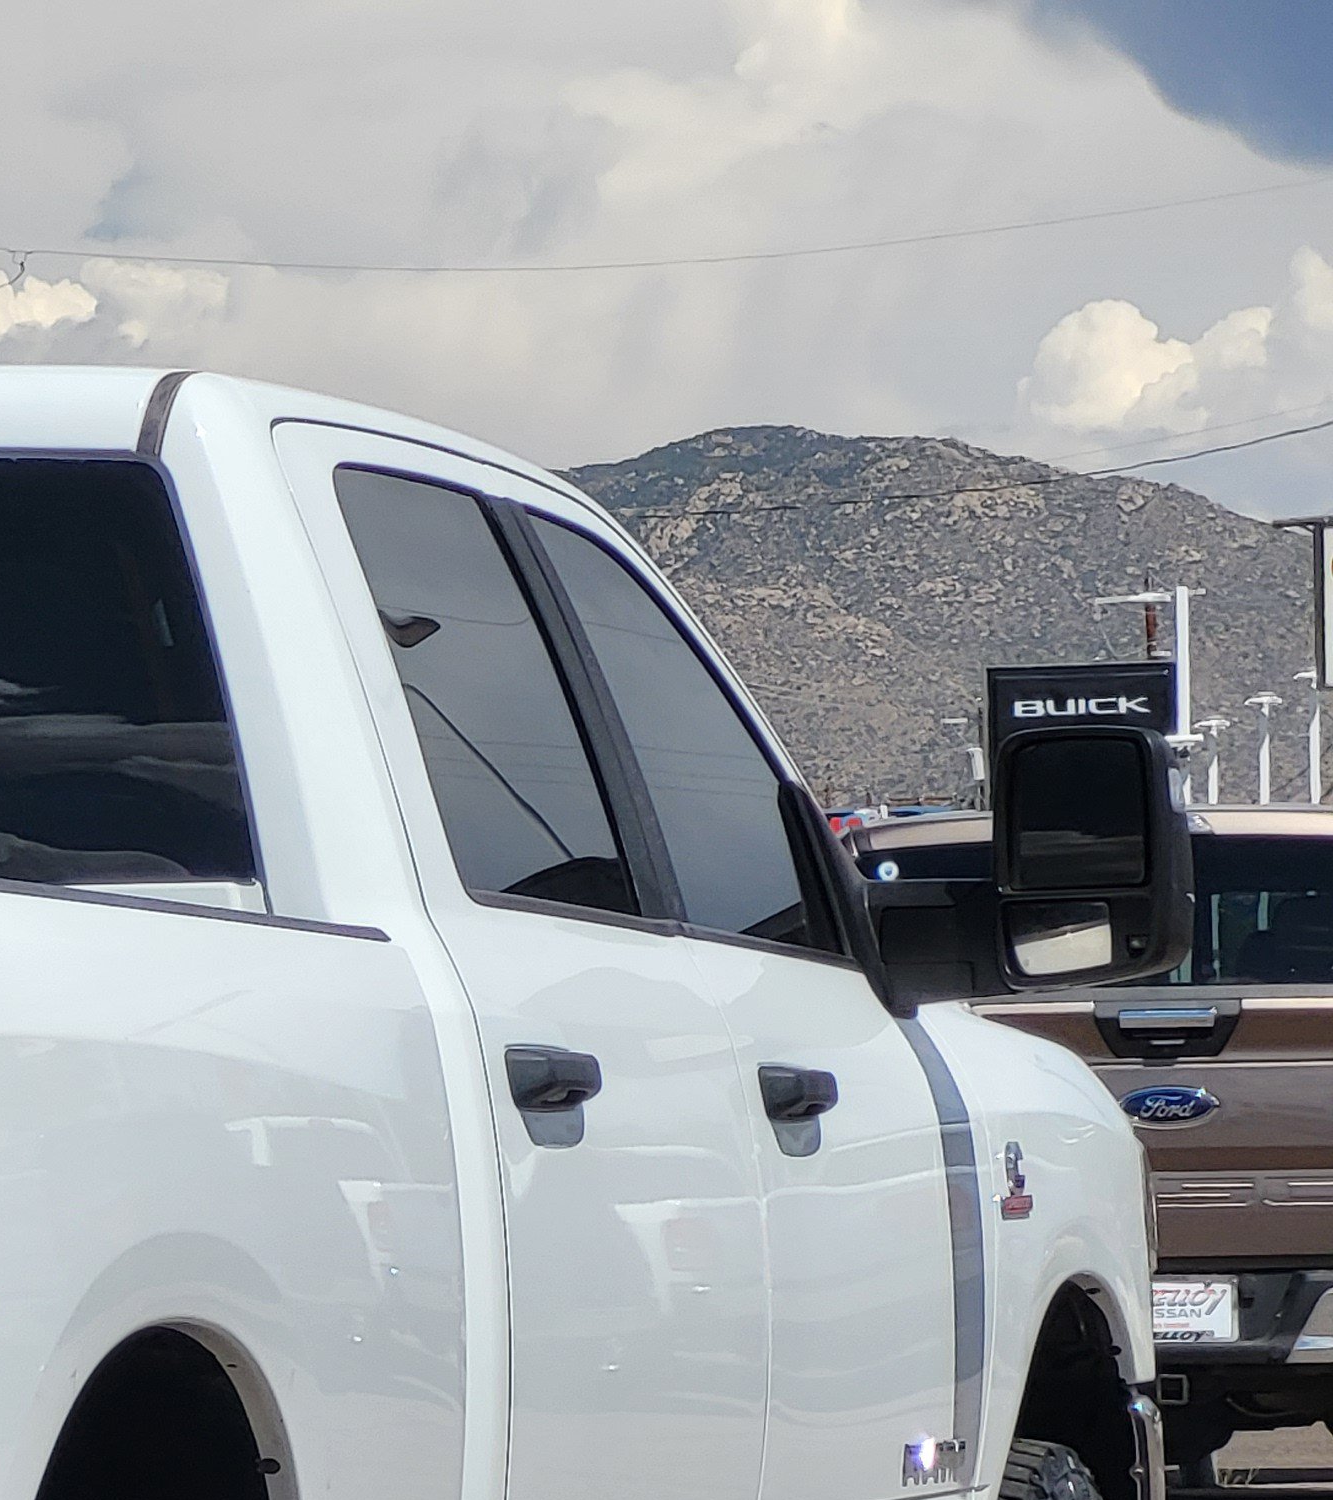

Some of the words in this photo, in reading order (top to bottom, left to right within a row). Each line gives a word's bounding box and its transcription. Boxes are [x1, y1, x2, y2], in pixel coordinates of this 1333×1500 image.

[1013, 697, 1151, 718] BUICK
[1140, 1095, 1195, 1118] Ford
[1152, 1288, 1228, 1316] ELLOY
[1154, 1308, 1202, 1319] SSAN
[1153, 1330, 1204, 1342] ELLOY
